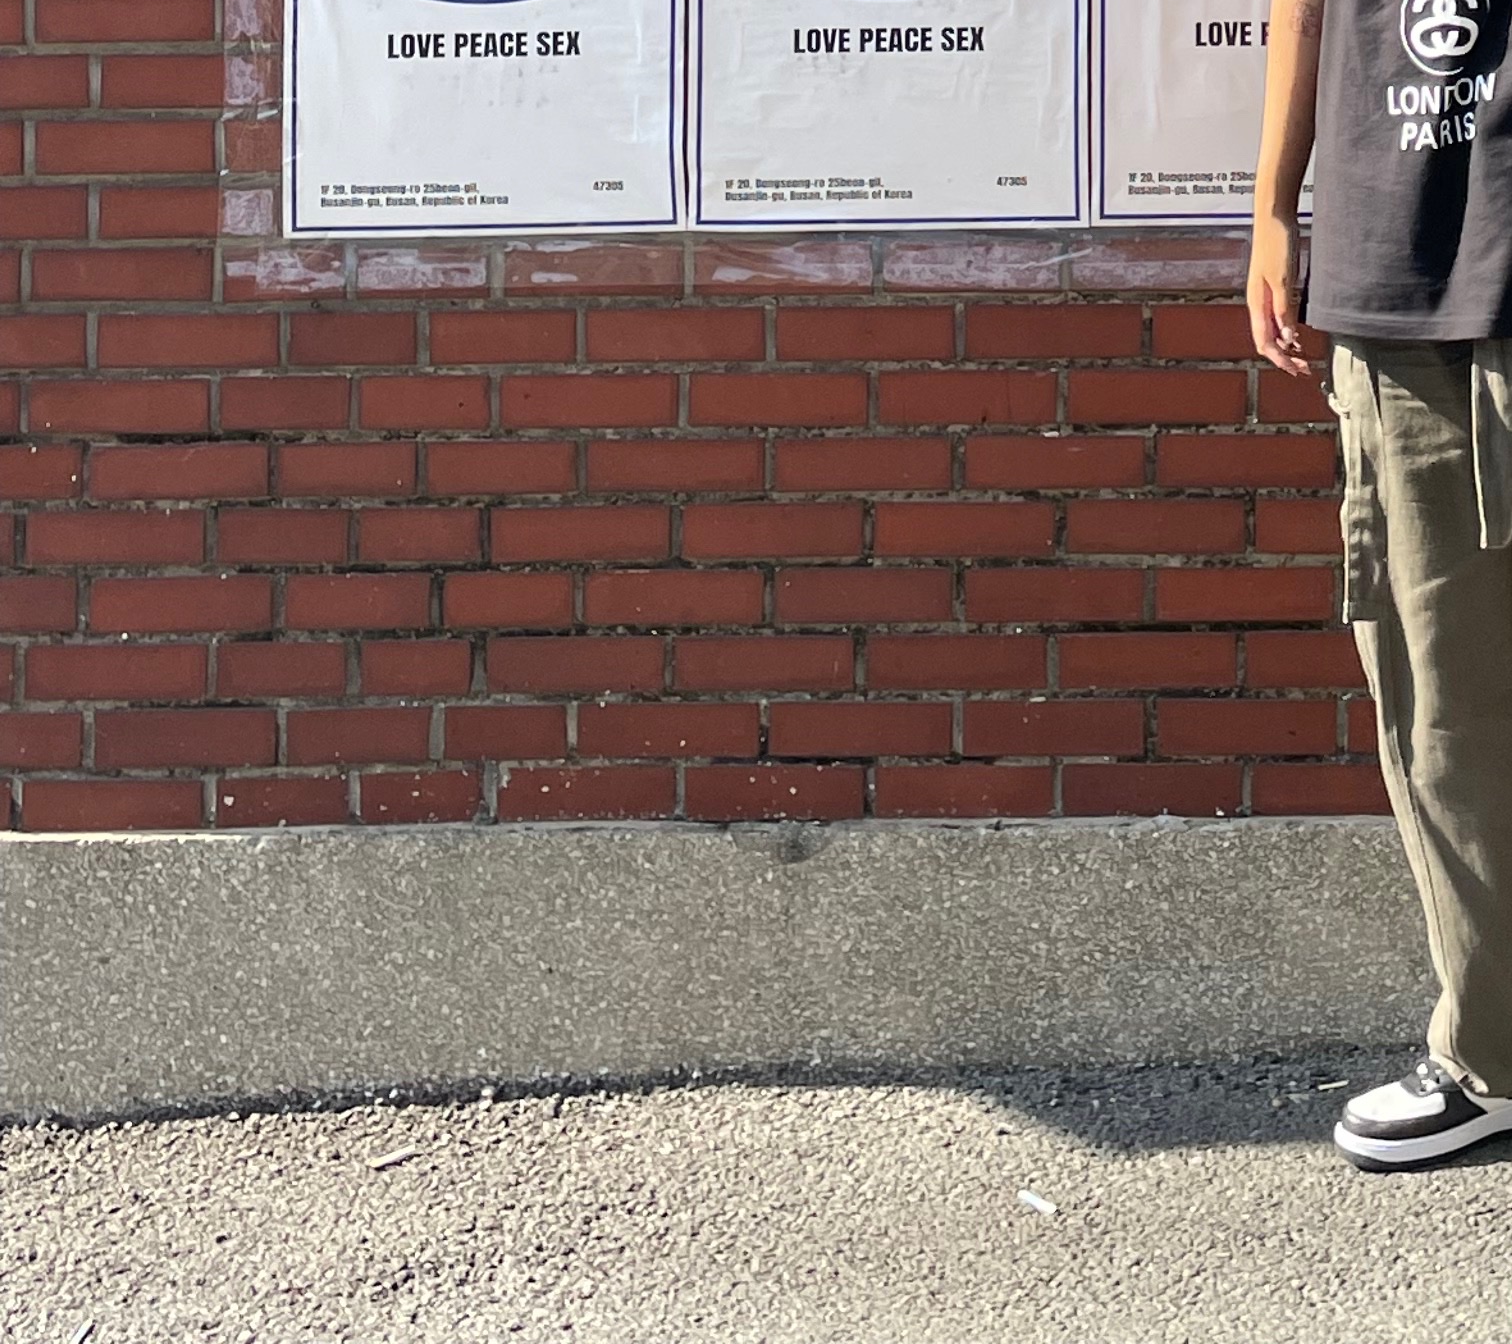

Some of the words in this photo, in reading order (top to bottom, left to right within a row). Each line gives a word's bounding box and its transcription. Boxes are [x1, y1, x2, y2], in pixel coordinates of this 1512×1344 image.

[388, 33, 445, 59] LOVE
[454, 32, 528, 58] PEACE
[537, 31, 580, 56] SEX
[794, 28, 850, 54] LOVE
[859, 27, 932, 53] PEACE
[941, 26, 984, 52] SEX
[1195, 22, 1252, 47] LOVE
[1400, 112, 1476, 151] PARIS
[480, 195, 509, 205] Korea
[884, 189, 912, 199] Korea
